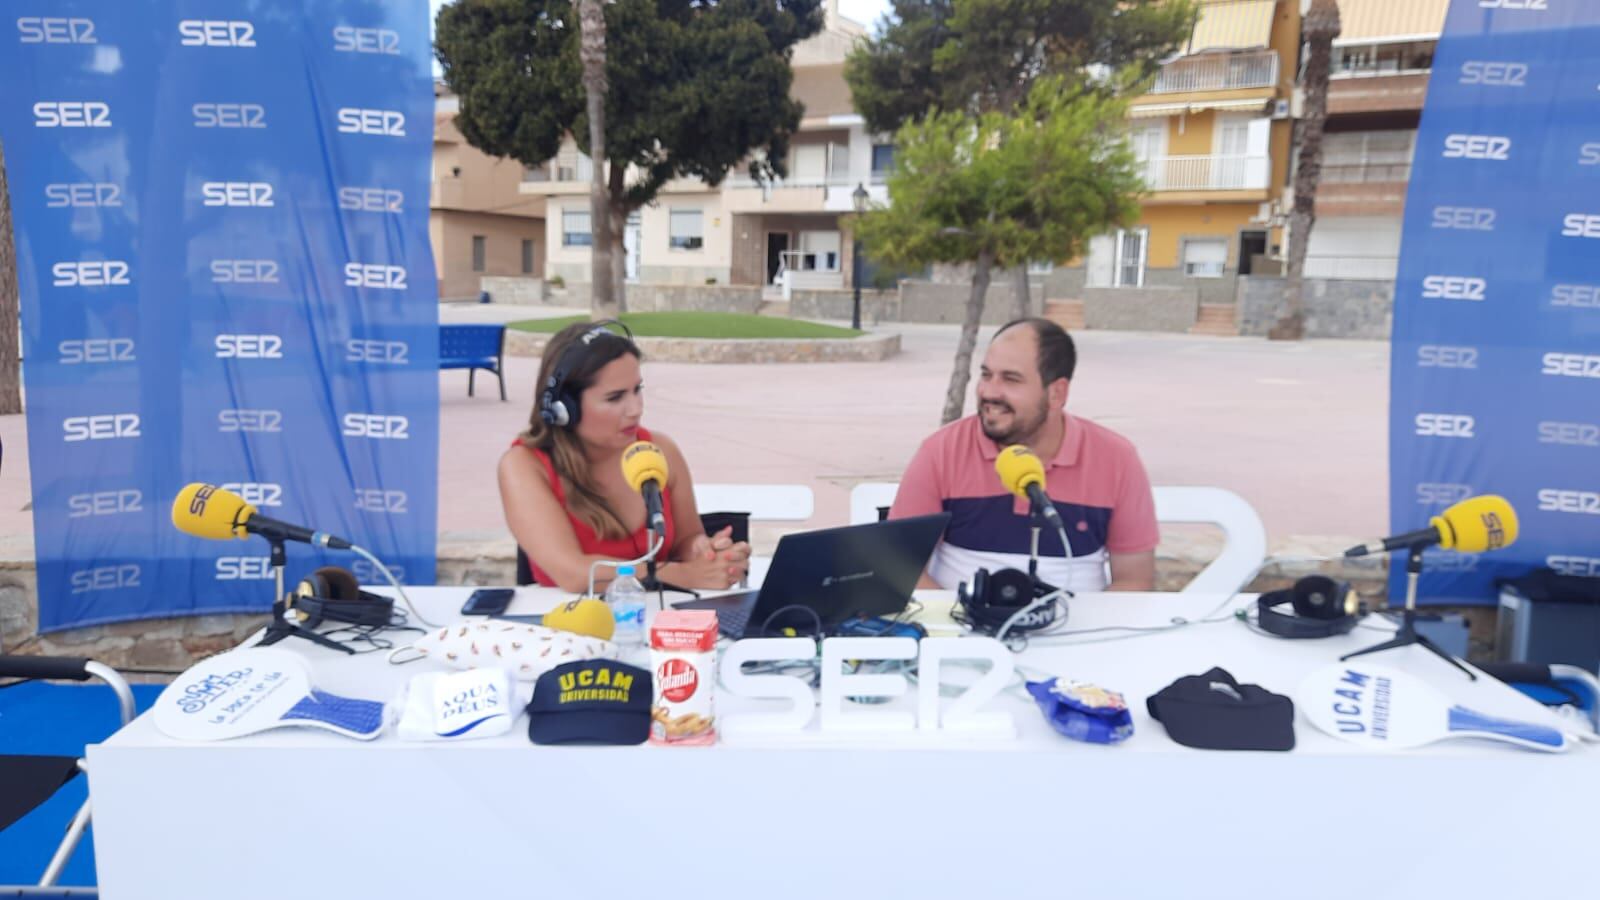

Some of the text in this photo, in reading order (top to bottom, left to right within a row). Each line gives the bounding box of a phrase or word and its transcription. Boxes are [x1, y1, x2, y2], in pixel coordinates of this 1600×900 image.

[17, 17, 97, 44] SER
[179, 20, 256, 47] SER
[333, 26, 400, 55] SER
[1459, 60, 1528, 87] SER
[33, 102, 112, 127] SER
[192, 104, 266, 128] SER
[337, 108, 406, 136] SER
[1442, 134, 1511, 160] SER
[45, 183, 122, 208] SER
[203, 182, 274, 206] SER
[338, 187, 403, 213] SER
[1431, 206, 1496, 231] SER
[1562, 213, 1600, 238] SE
[52, 261, 130, 286] SER
[210, 259, 279, 283] SER
[344, 262, 407, 289] SER
[1421, 275, 1486, 301] SER
[58, 338, 136, 364] SER
[215, 334, 283, 359] SER
[346, 338, 409, 365] SER
[1417, 345, 1478, 369] SER
[63, 414, 141, 441] SER
[218, 409, 282, 433] SER
[343, 413, 409, 439] SER
[1415, 413, 1474, 438] SER
[1538, 421, 1600, 446] SER
[68, 489, 143, 518] SER
[188, 484, 217, 517] SE
[1480, 511, 1504, 551] SE
[71, 564, 141, 594] SER
[558, 668, 633, 691] UCAM
[719, 637, 1015, 731] SER
[442, 683, 498, 708] AQUA
[559, 689, 630, 704] UNIVERSIDAD
[1333, 670, 1371, 732] UCAM
